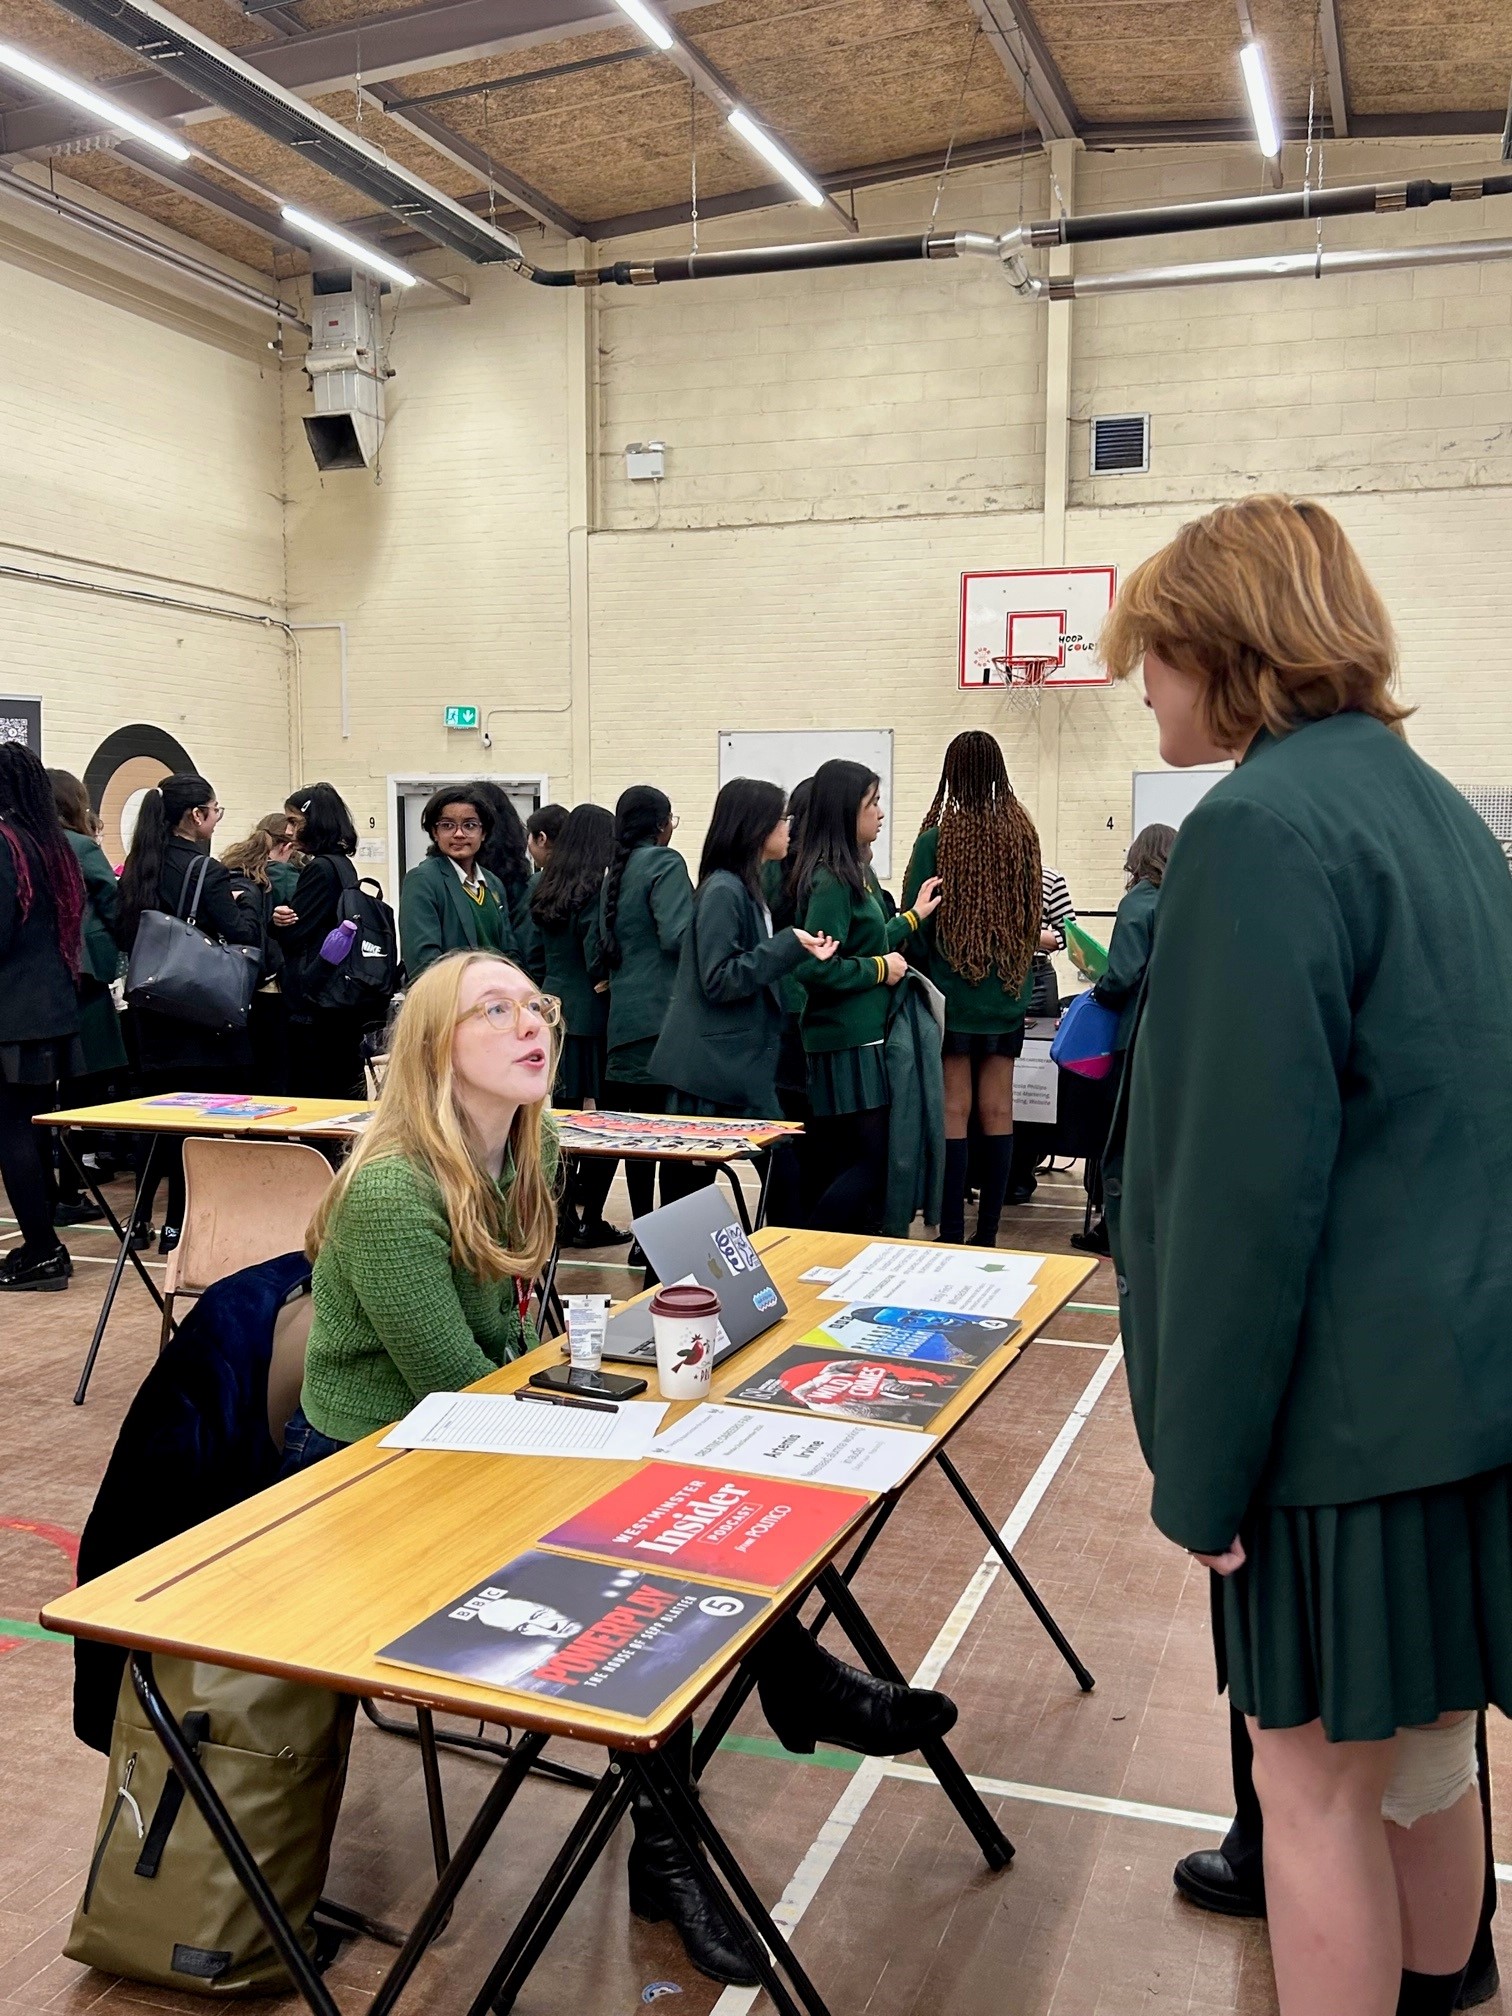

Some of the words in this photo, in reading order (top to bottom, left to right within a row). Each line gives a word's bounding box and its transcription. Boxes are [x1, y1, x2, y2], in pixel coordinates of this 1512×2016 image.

[1058, 634, 1083, 644] HOOP
[369, 816, 375, 829] 9
[1106, 816, 1114, 830] 4
[361, 939, 382, 954] NIKE
[851, 1325, 894, 1350] PLEASE
[865, 1328, 913, 1354] PROTECT
[807, 1378, 854, 1400] WILD
[848, 1366, 887, 1397] CRIMES
[763, 1434, 801, 1458] Artemis
[793, 1440, 824, 1458] Irvine
[612, 1479, 708, 1544] WESTMINSTER
[634, 1482, 751, 1555] Insider
[706, 1505, 755, 1542] PODCAST
[734, 1537, 758, 1553] from
[749, 1504, 792, 1538] POLITICO
[451, 1588, 505, 1619] BBC
[705, 1599, 737, 1613] 5
[531, 1584, 681, 1686] POWERPLAY
[584, 1671, 609, 1687] THE
[602, 1649, 636, 1673] HOUSE
[628, 1638, 646, 1650] OF
[640, 1621, 666, 1640] SEPP
[660, 1595, 698, 1623] BLATTER
